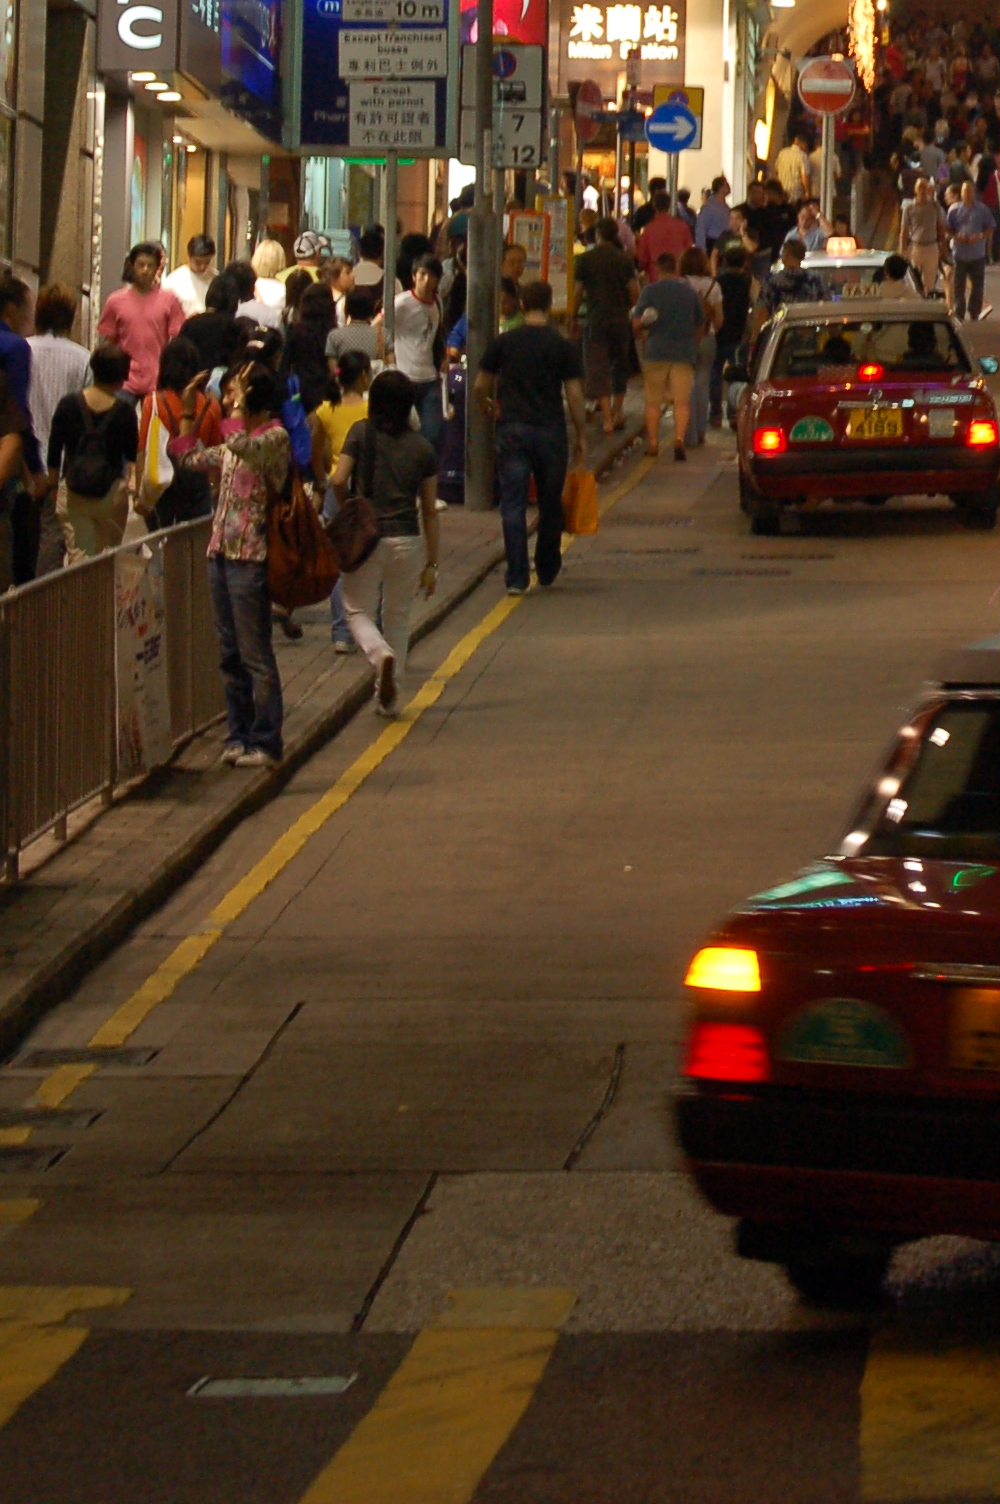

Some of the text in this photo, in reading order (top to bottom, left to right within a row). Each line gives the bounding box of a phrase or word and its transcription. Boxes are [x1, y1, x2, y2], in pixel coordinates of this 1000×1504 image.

[397, 0, 417, 16] 10
[421, 4, 440, 18] m
[343, 30, 442, 44] Except franchised
[377, 45, 408, 54] buses
[372, 85, 412, 95] Except
[360, 98, 425, 108] with permit
[512, 114, 525, 133] 7
[512, 144, 536, 164] 12
